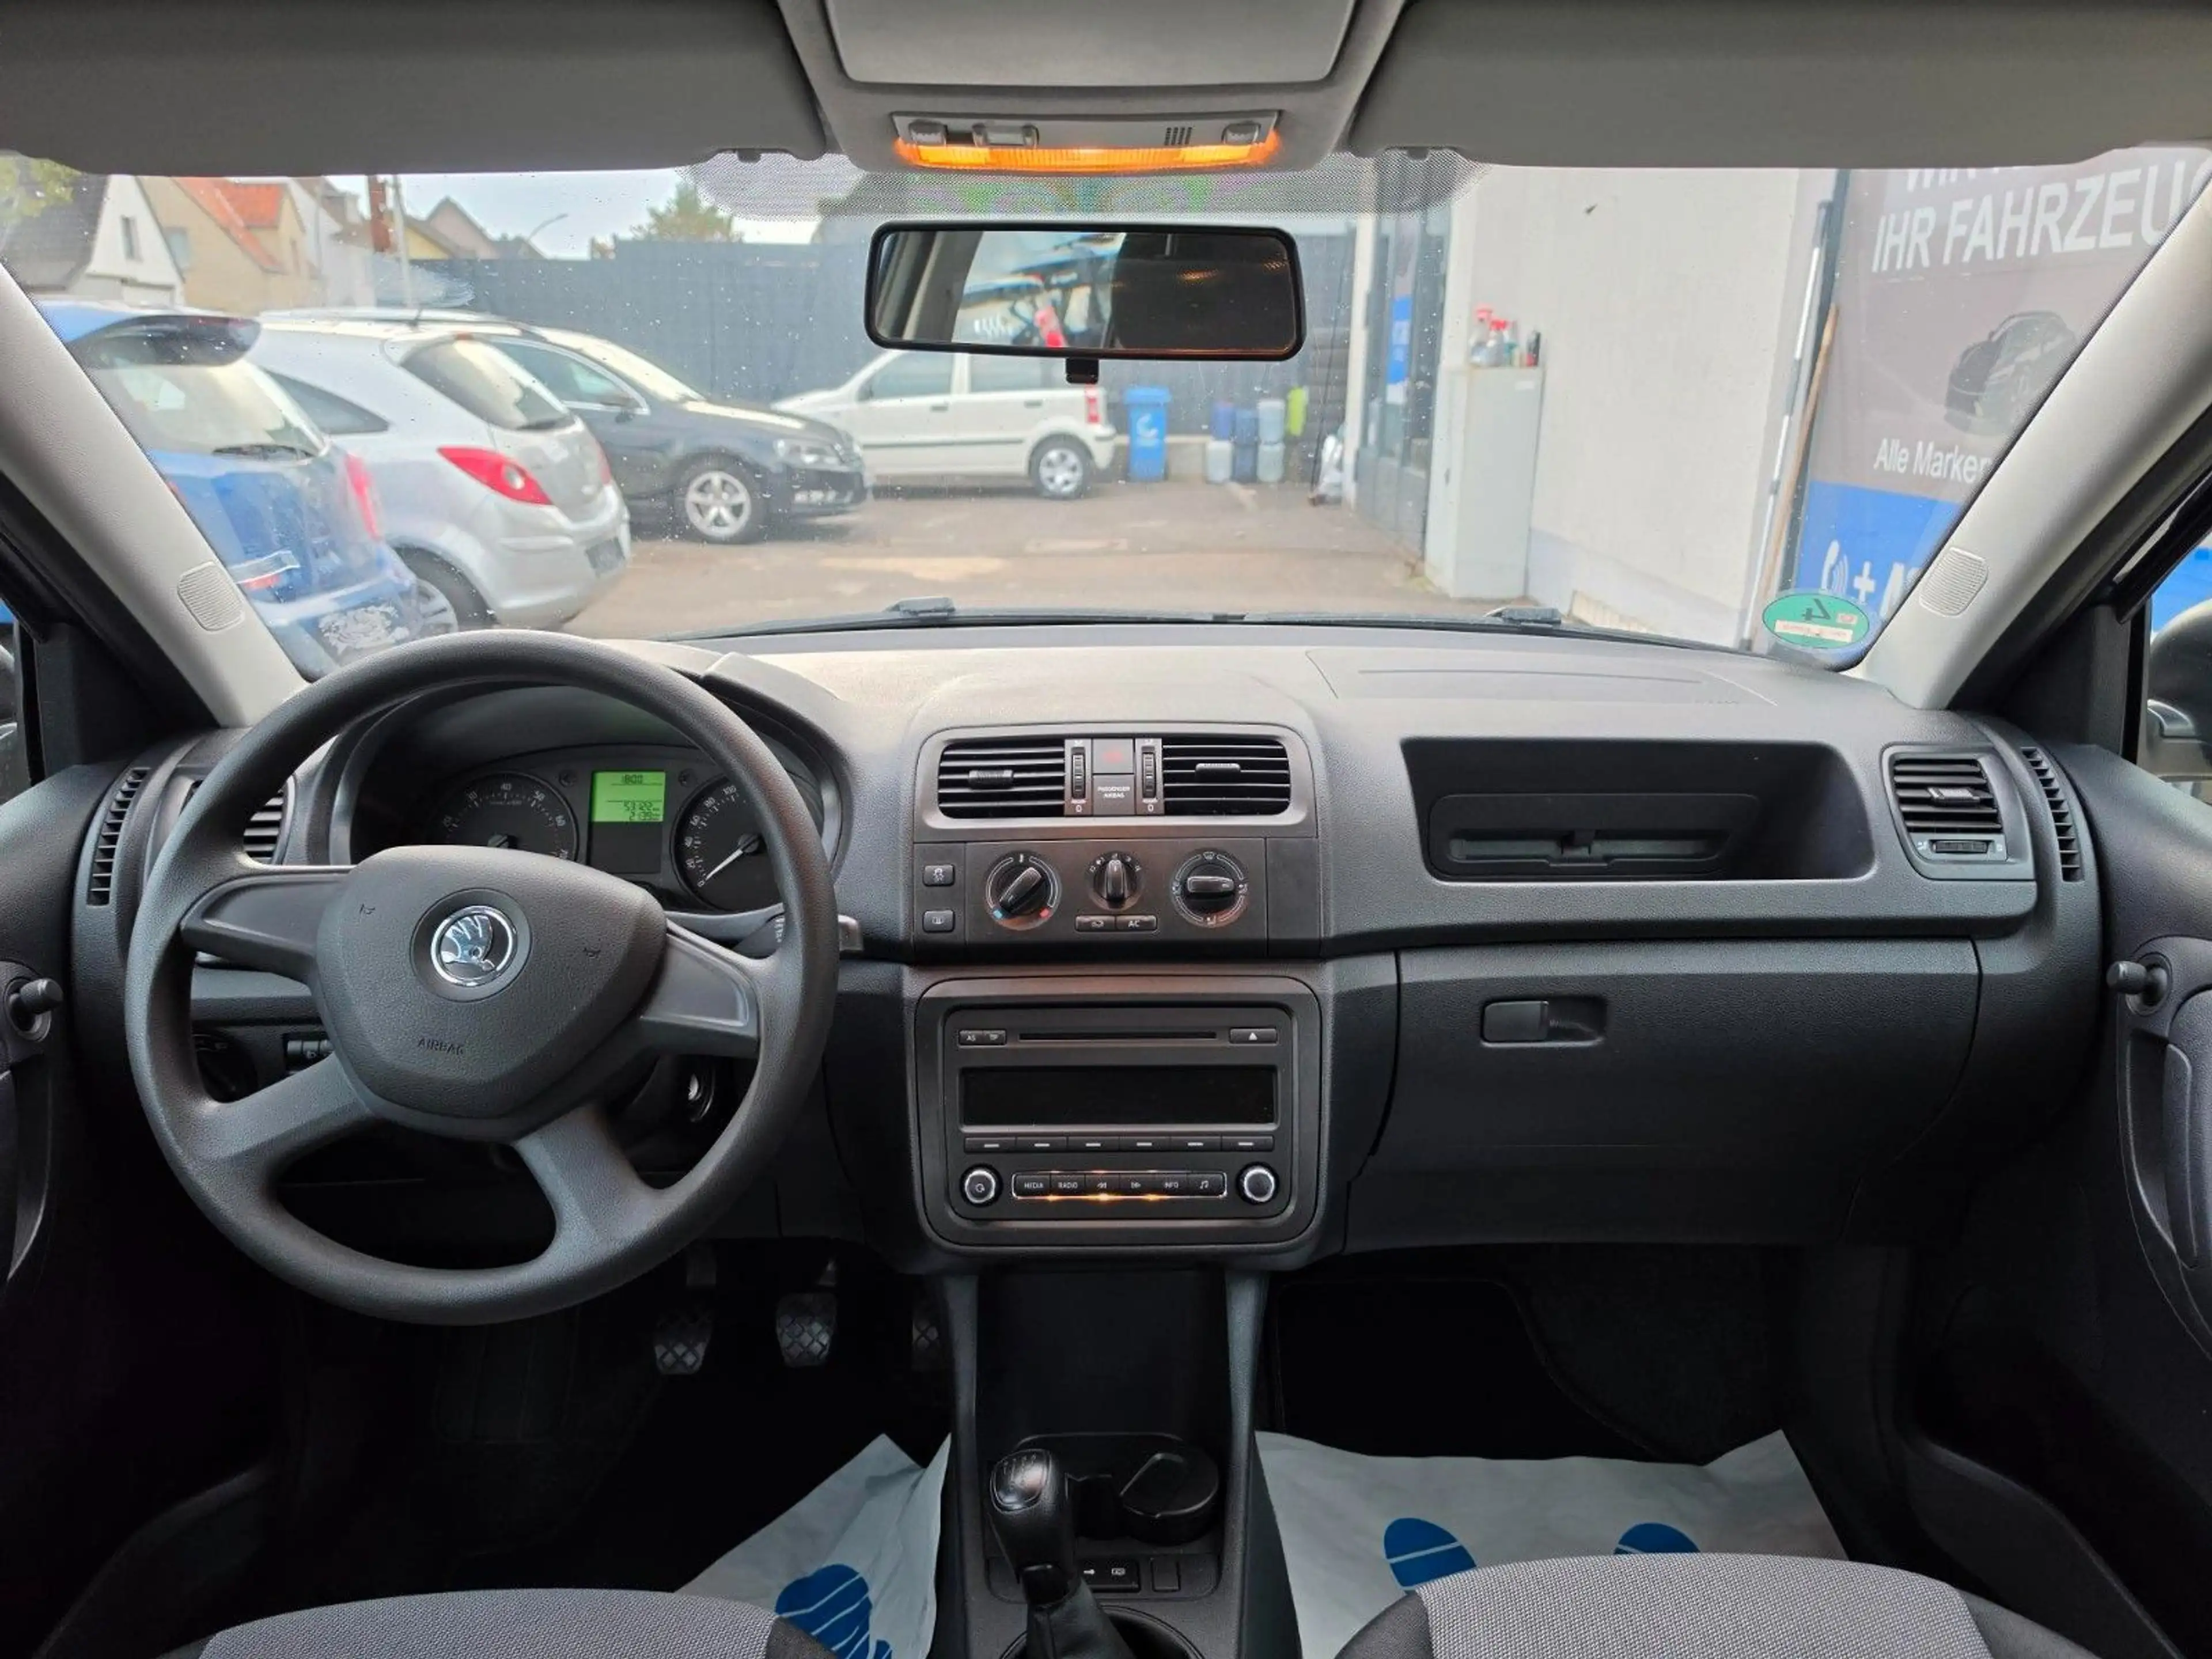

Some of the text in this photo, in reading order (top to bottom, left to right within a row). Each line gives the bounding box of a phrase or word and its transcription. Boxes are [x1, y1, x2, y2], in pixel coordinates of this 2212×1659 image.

[1872, 154, 2211, 272] IHR FAHRZEU
[1873, 437, 1910, 474] Alle
[417, 1037, 464, 1055] AIRBAG
